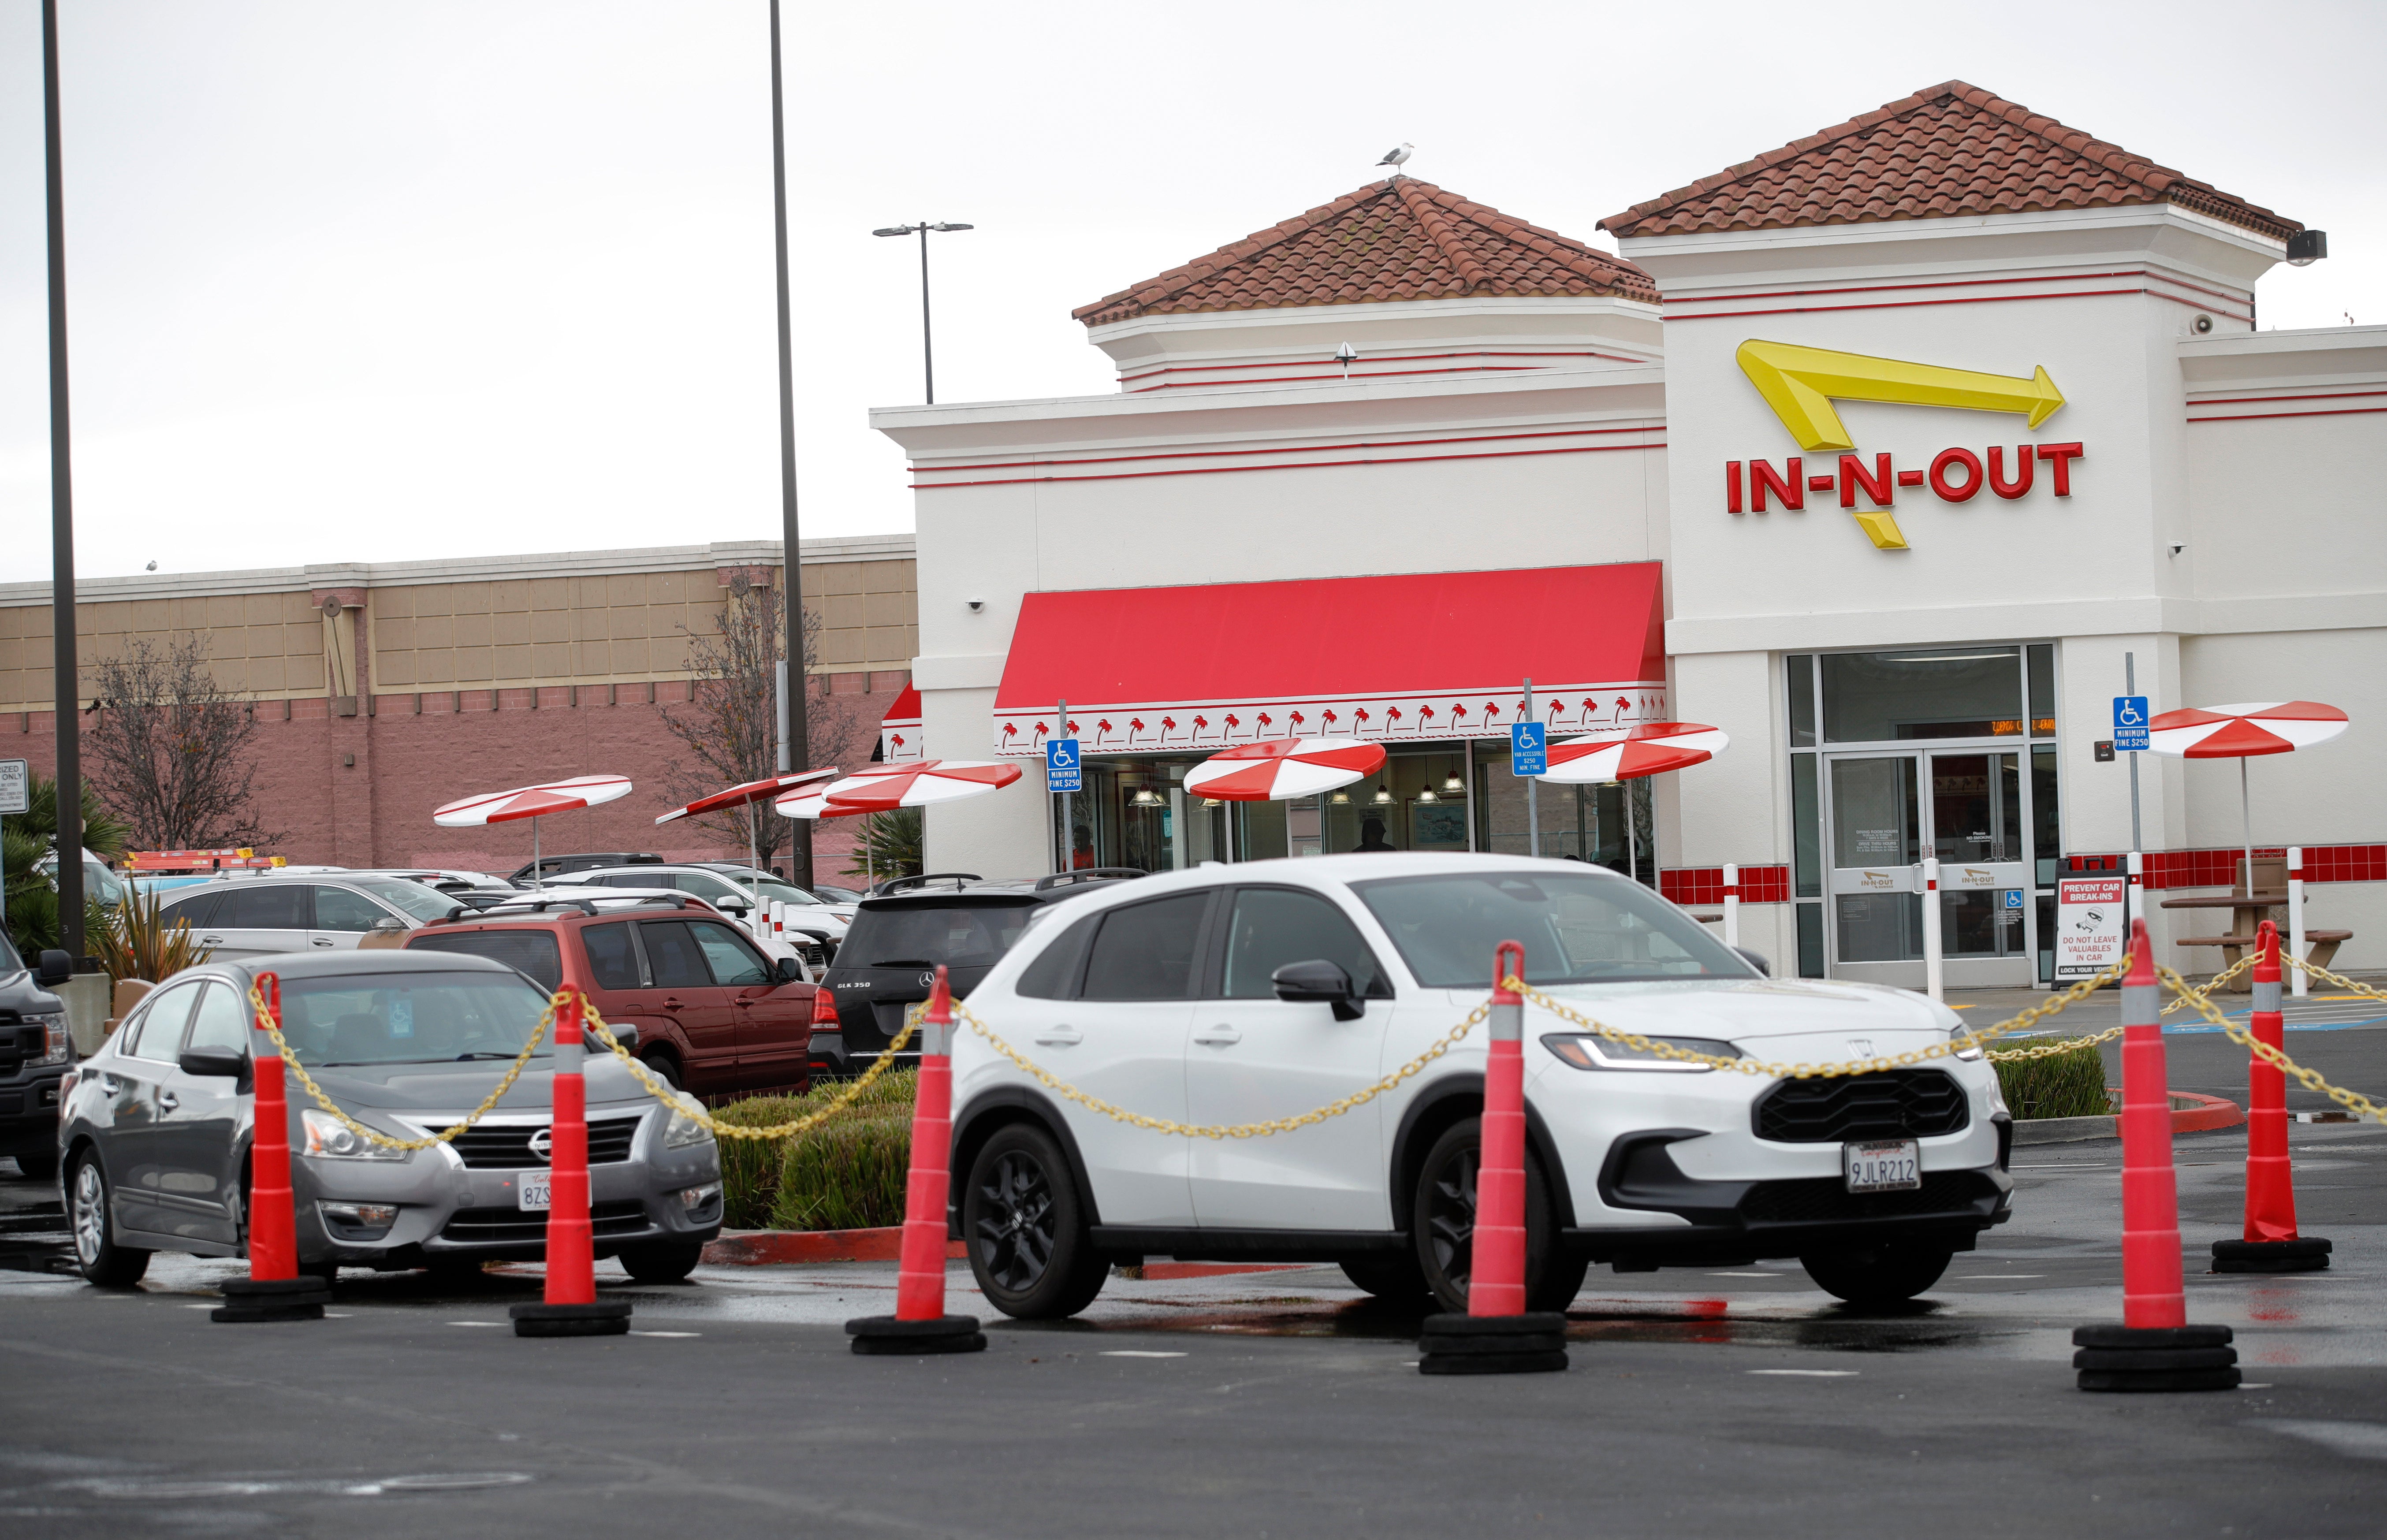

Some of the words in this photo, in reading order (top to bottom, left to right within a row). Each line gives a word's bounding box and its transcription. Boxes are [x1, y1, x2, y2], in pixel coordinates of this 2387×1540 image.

[1727, 442, 2085, 514] IN-N-OUT
[2131, 738, 2148, 747] $250
[1065, 779, 1080, 787] $250
[2064, 884, 2100, 892] PREVENT
[2070, 893, 2113, 901] BREAK-INS
[63, 925, 69, 934] 3
[1852, 1160, 1914, 1183] 9JLR212
